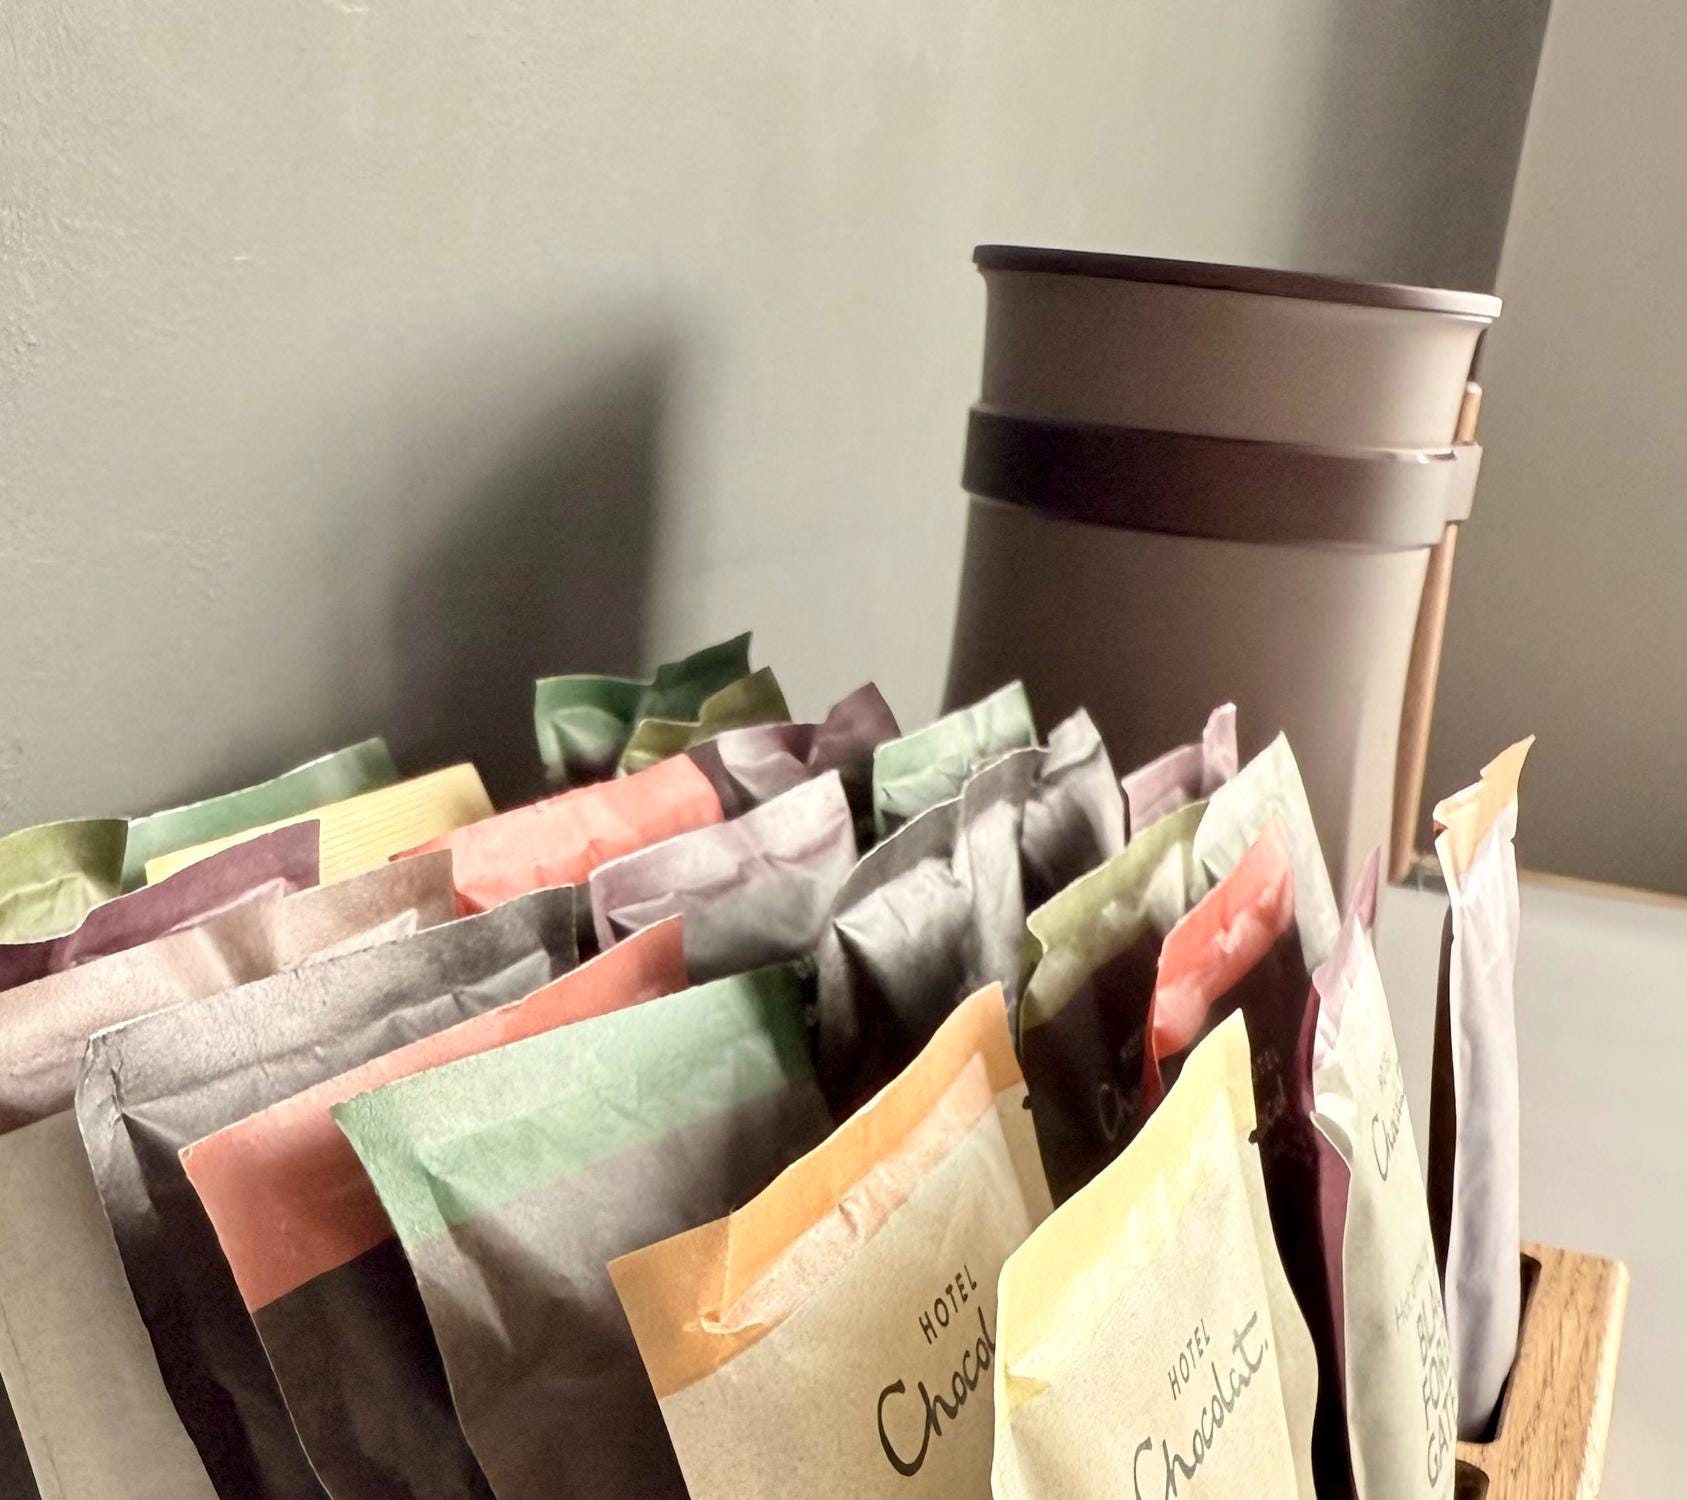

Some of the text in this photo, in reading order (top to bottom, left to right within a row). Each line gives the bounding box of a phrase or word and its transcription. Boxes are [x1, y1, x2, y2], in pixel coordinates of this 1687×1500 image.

[919, 1264, 977, 1344] HOTEL
[877, 1305, 995, 1477] Chocol
[1167, 1317, 1210, 1401] HOTEL
